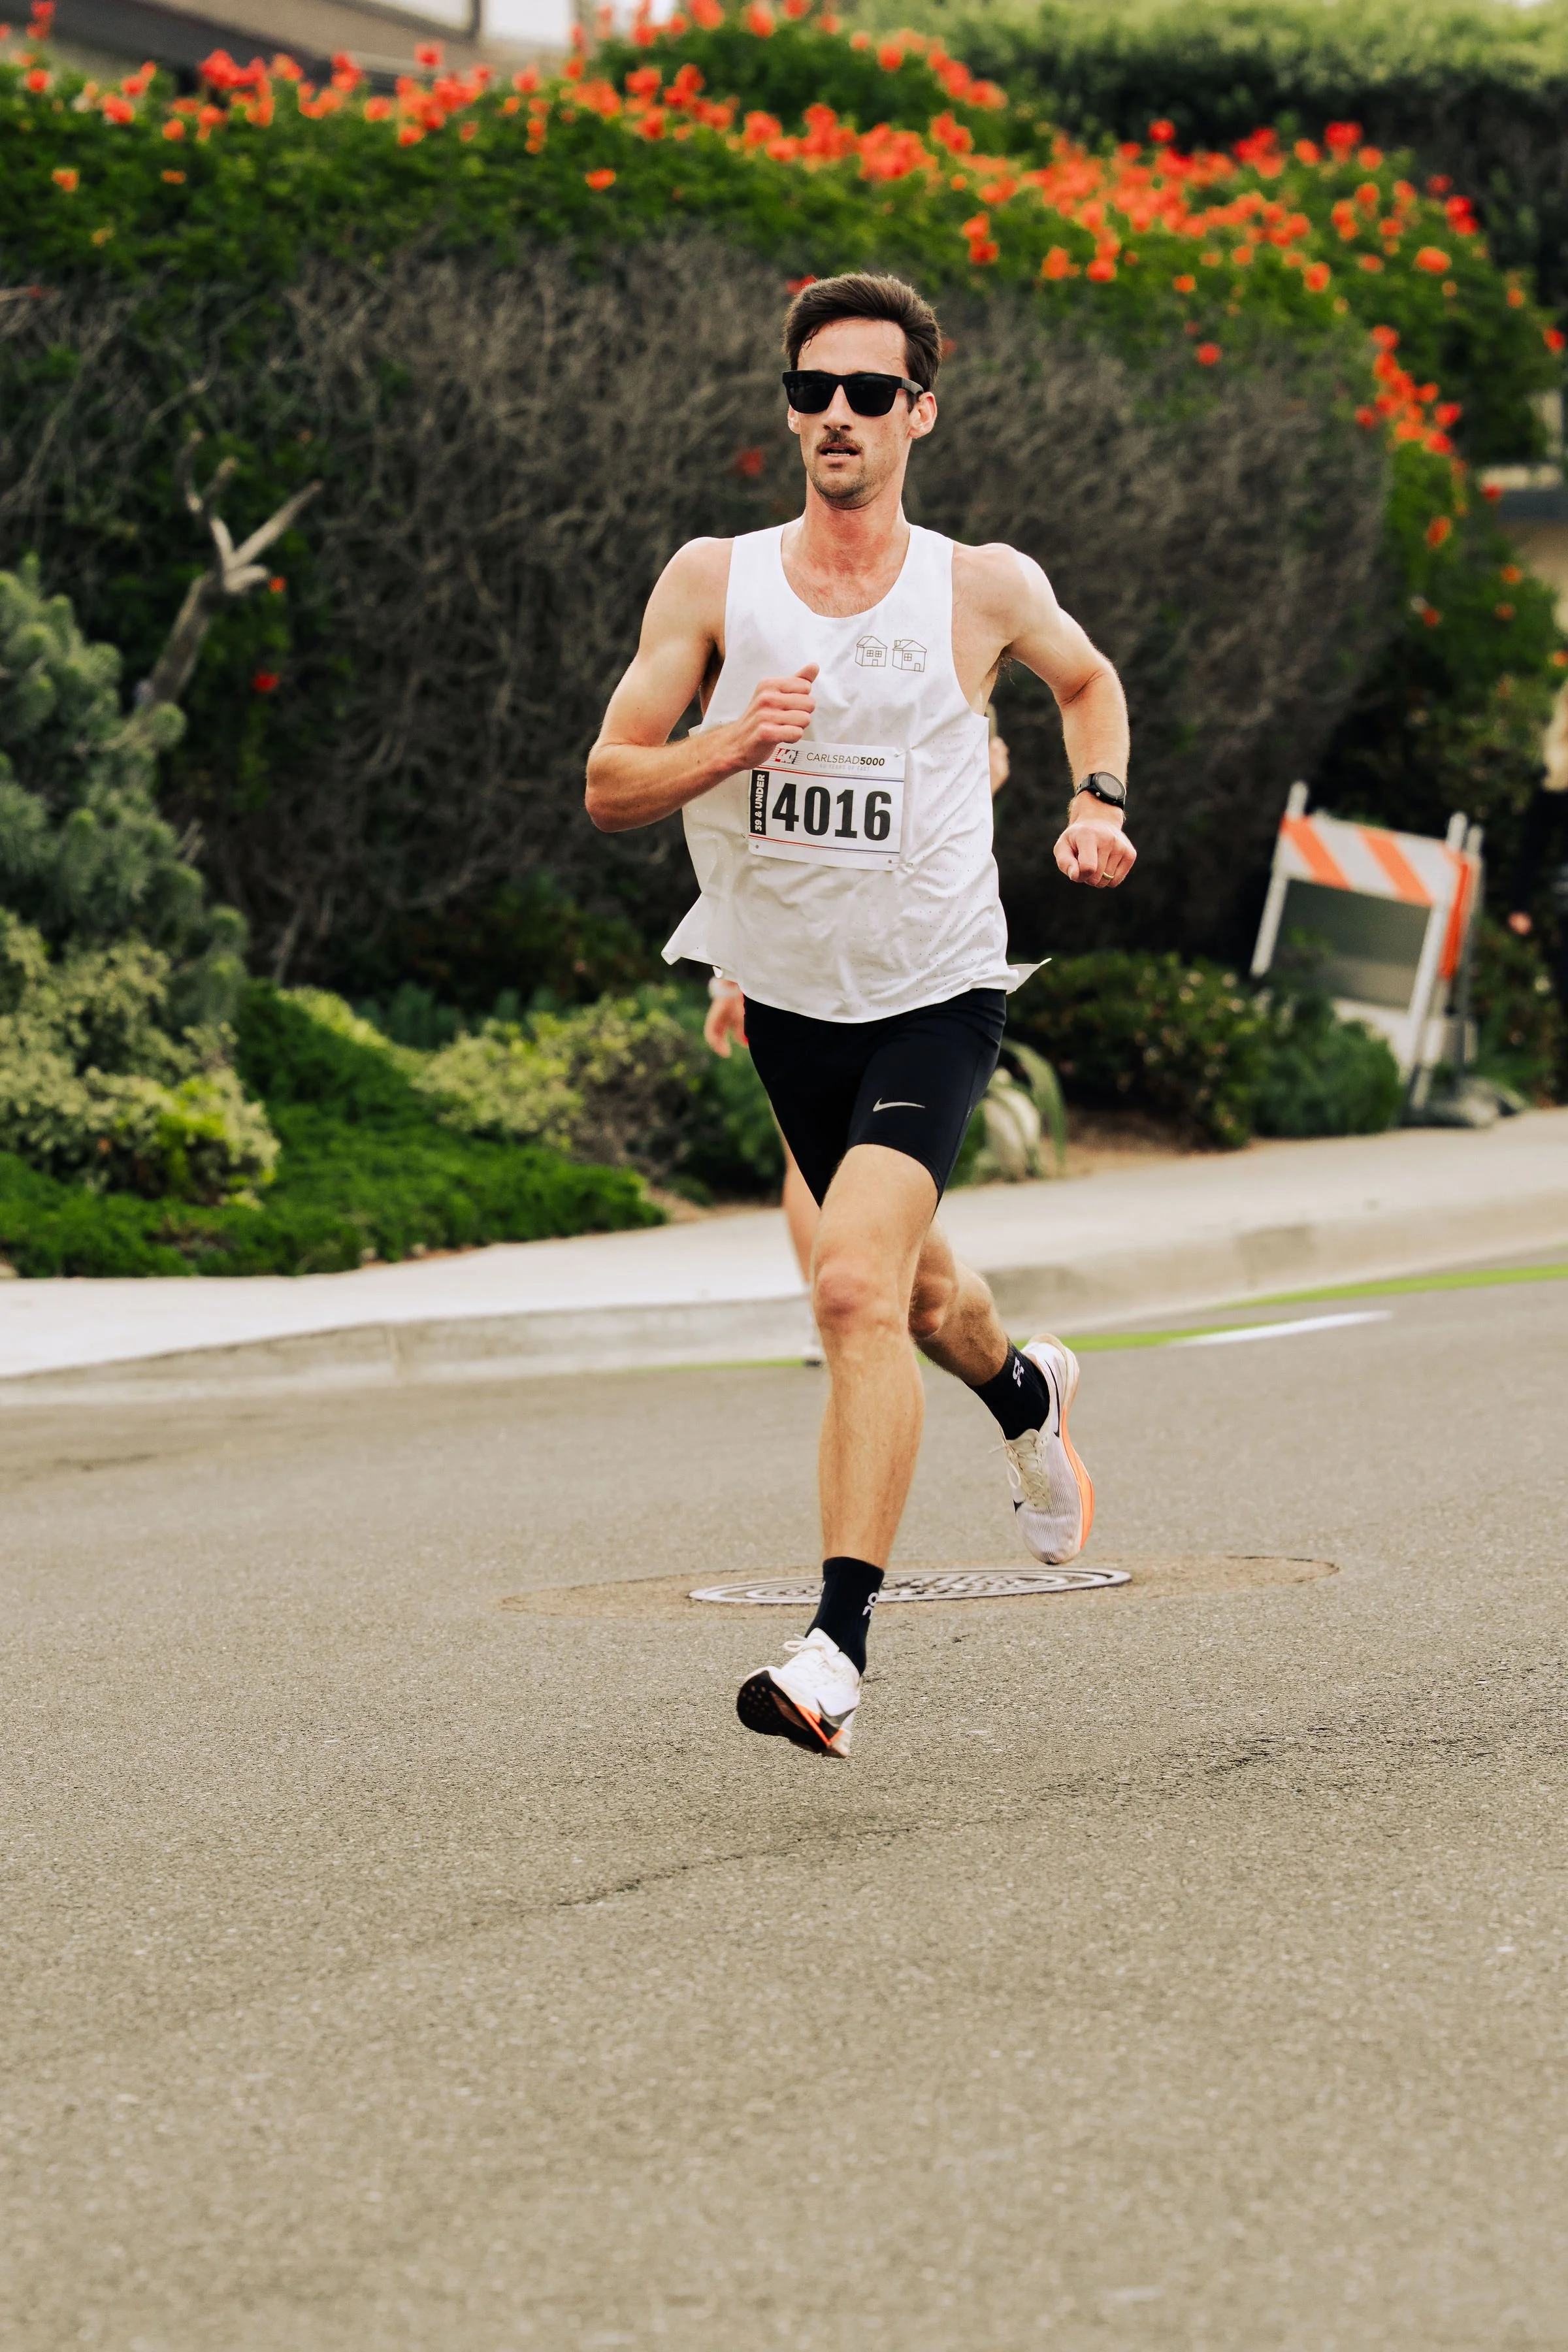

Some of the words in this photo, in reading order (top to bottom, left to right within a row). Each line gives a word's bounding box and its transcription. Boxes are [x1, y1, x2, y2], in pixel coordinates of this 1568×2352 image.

[806, 752, 885, 766] CARLSBAD5000
[755, 774, 765, 809] UNDER
[772, 783, 892, 841] 4016
[754, 819, 762, 832] 39
